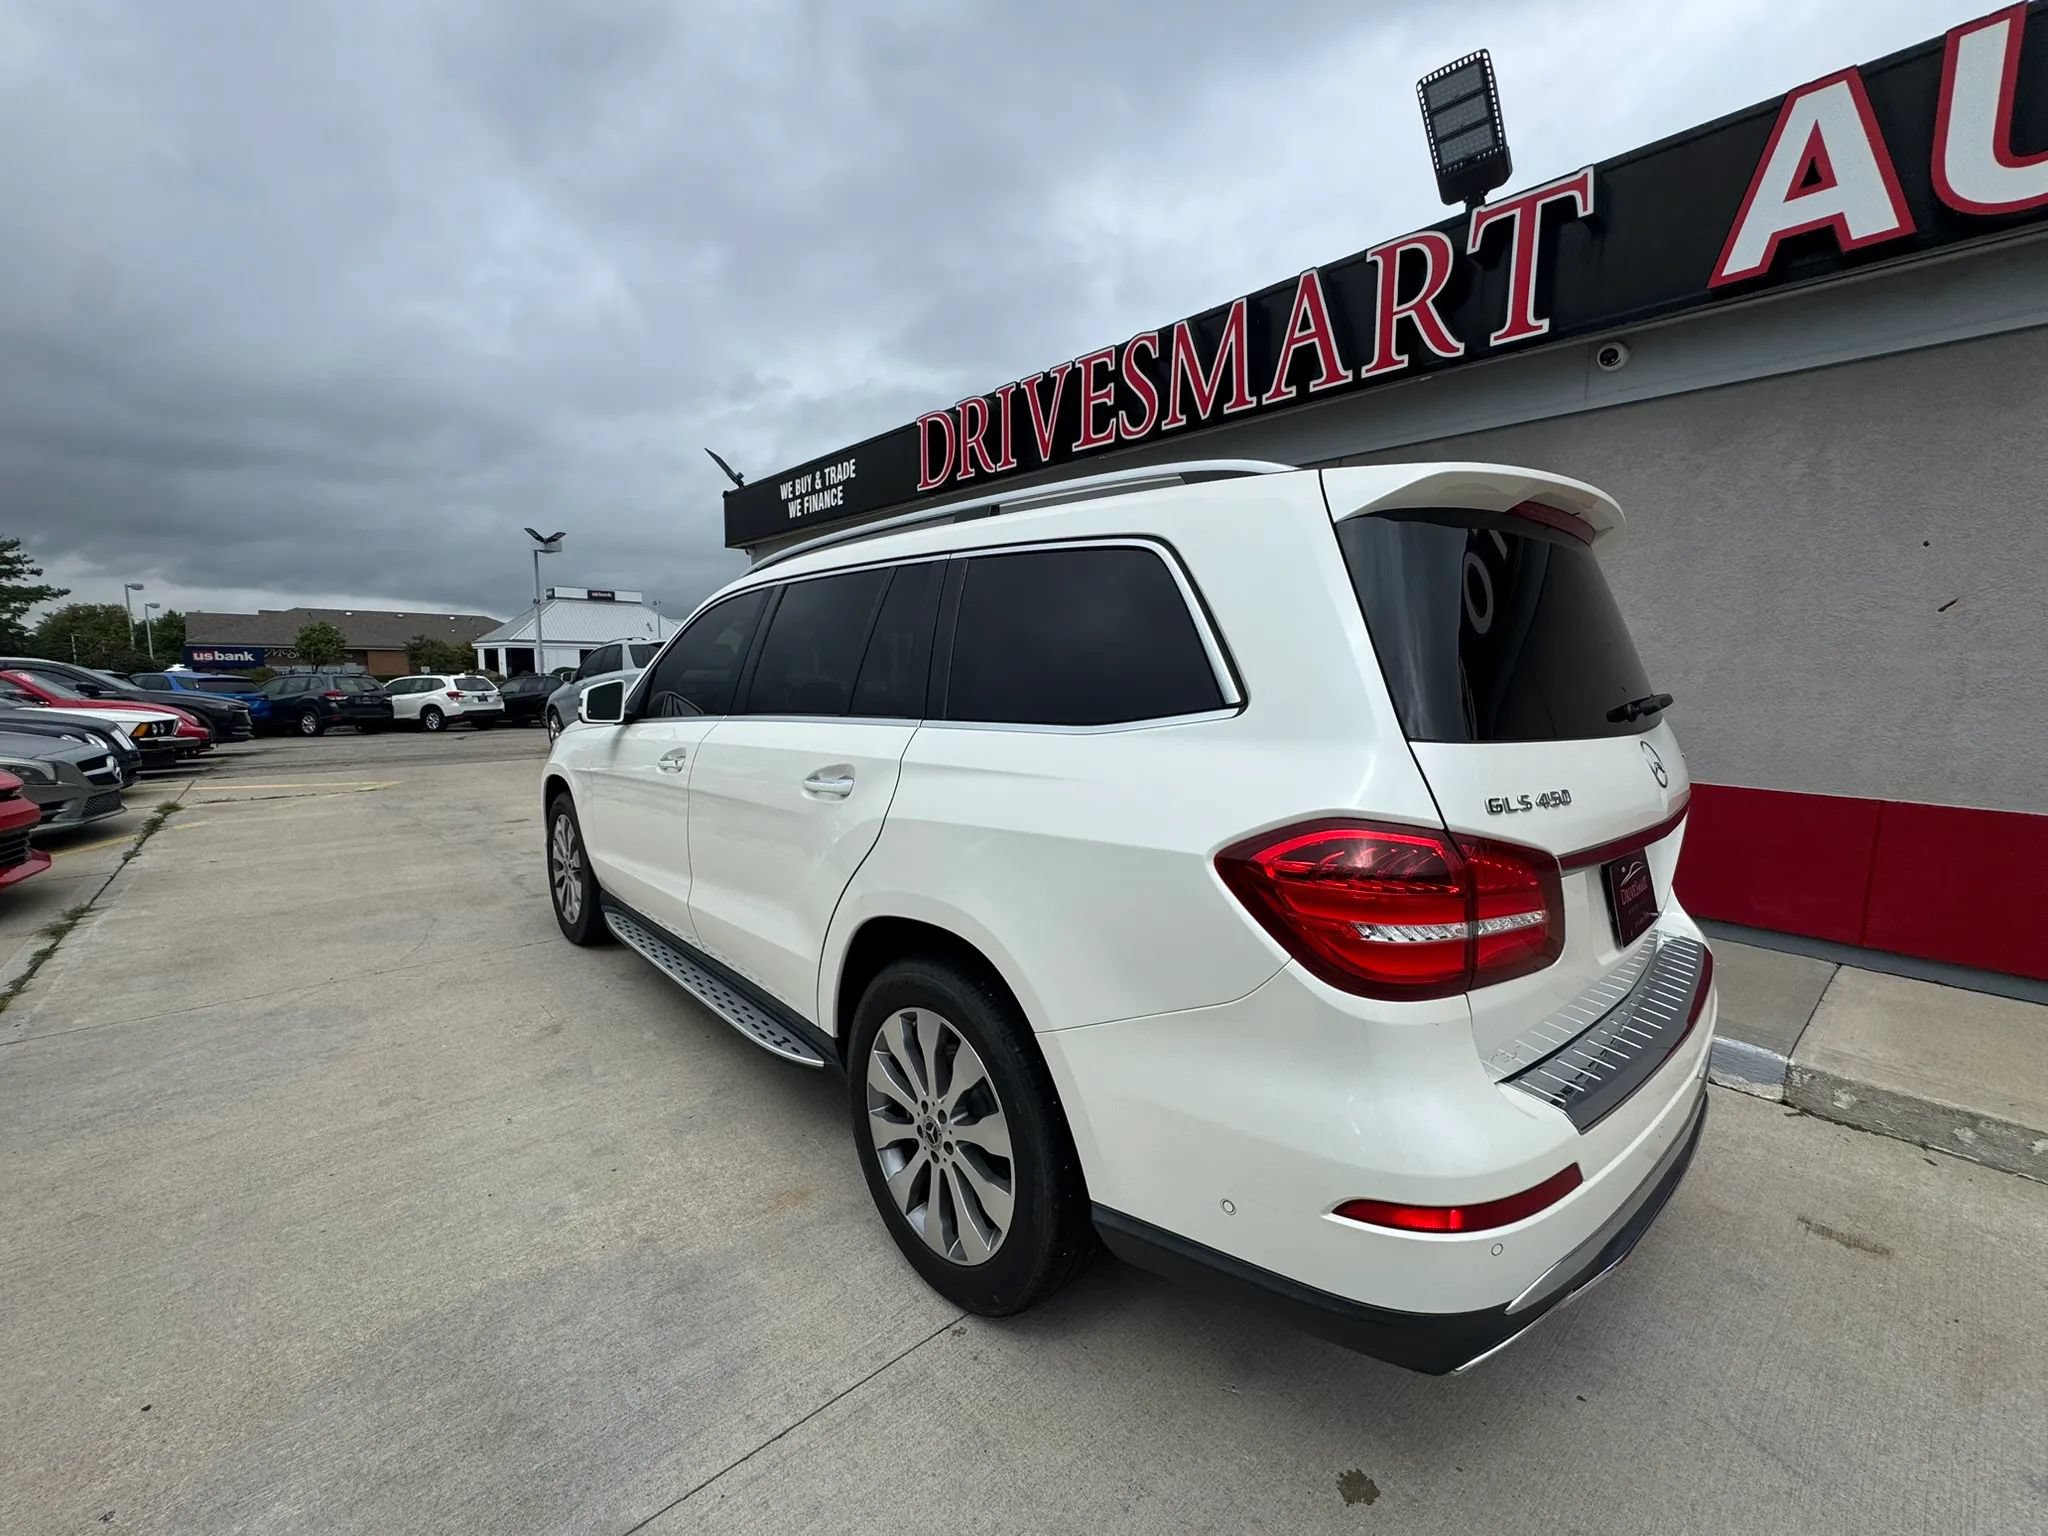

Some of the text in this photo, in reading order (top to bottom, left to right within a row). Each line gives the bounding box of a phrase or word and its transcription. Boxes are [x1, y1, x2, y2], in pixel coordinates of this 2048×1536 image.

[917, 165, 1594, 492] DRIVESMART
[780, 459, 856, 500] WE BUY & TRADE
[788, 485, 844, 519] WE FINANCE
[1484, 789, 1572, 815] GLS 450
